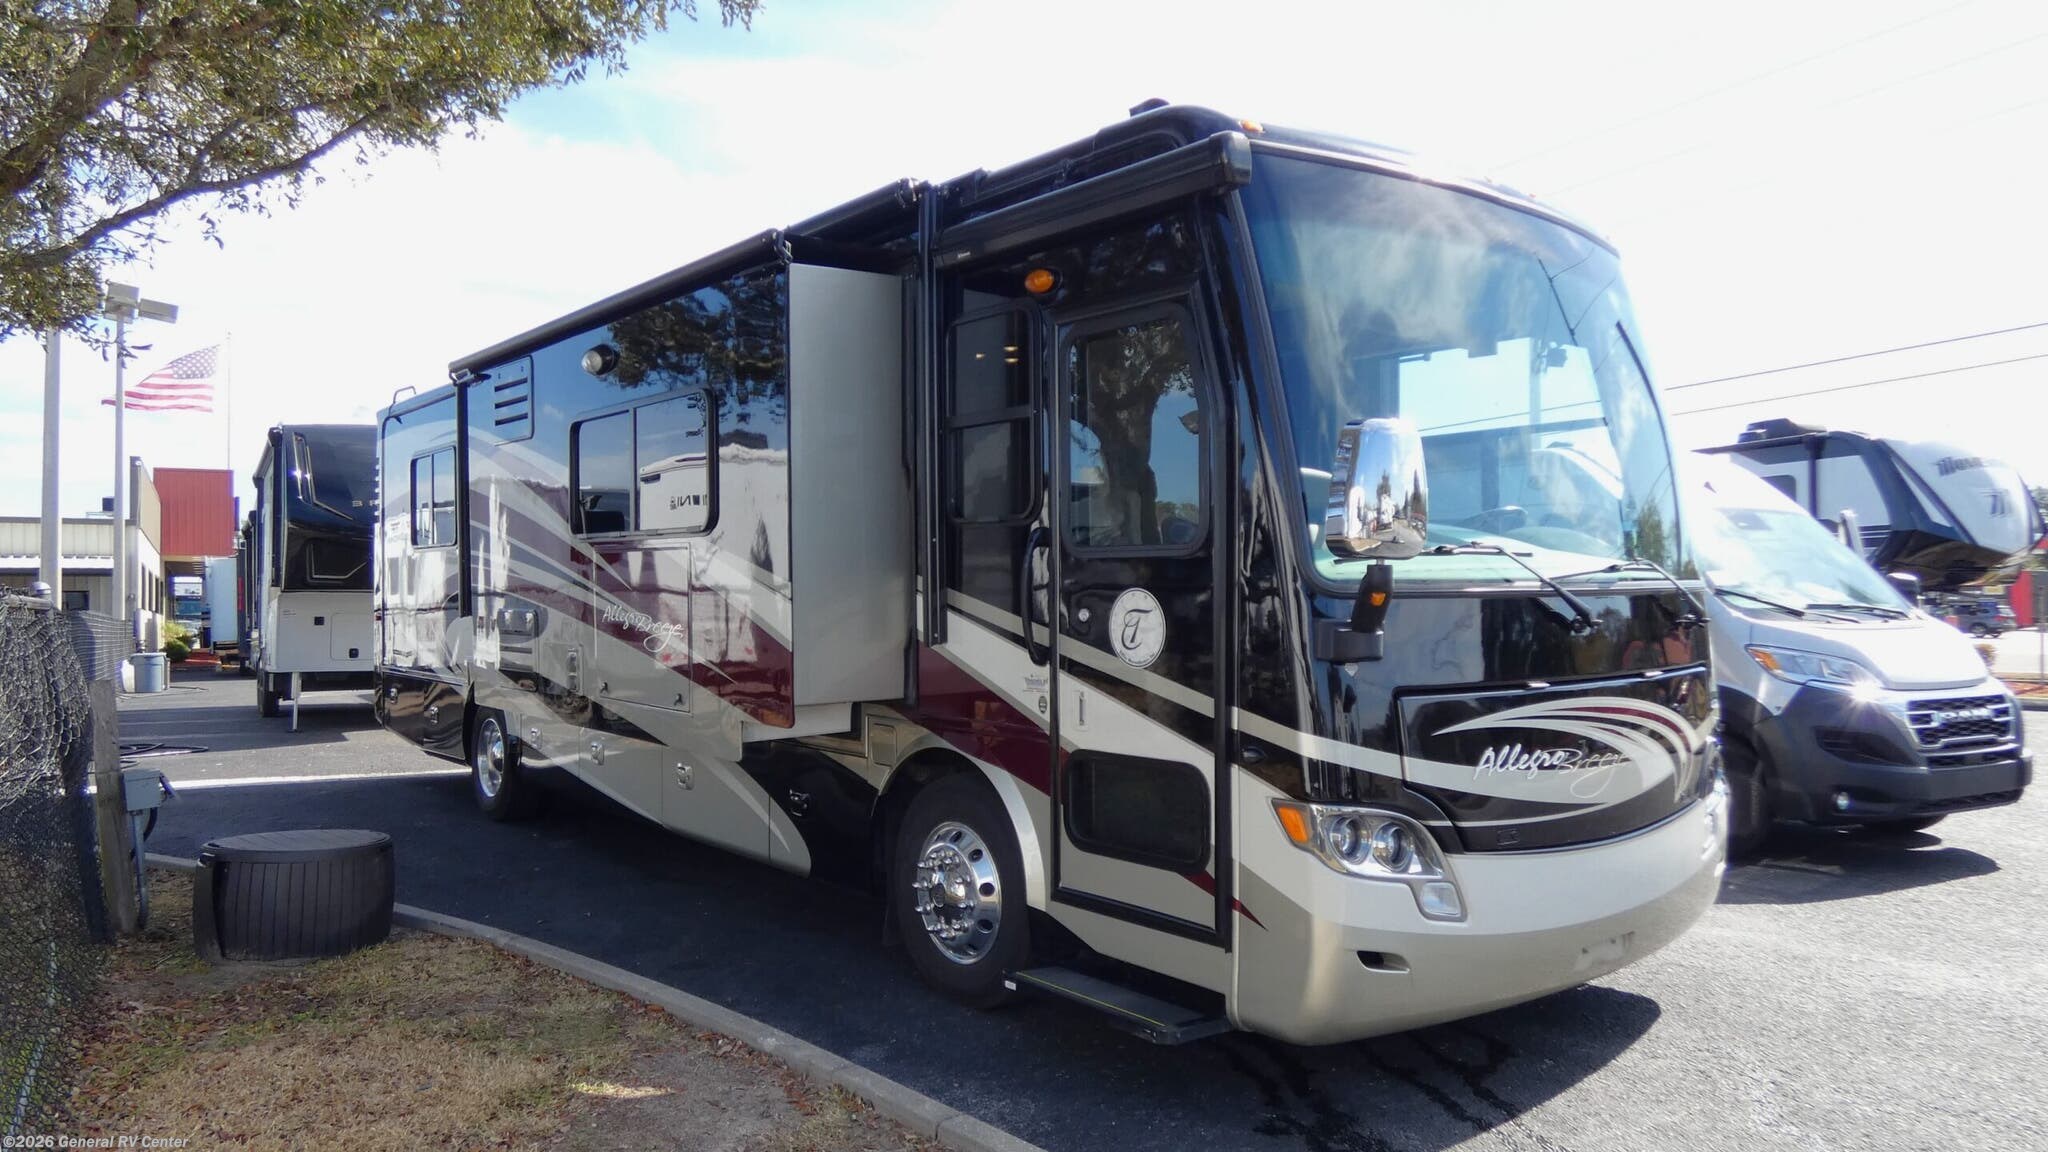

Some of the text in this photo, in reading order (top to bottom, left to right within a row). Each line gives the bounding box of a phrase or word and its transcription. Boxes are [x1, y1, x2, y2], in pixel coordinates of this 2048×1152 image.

[602, 605, 684, 653] Allegro Breeze
[1473, 743, 1632, 798] Allegro Breeze
